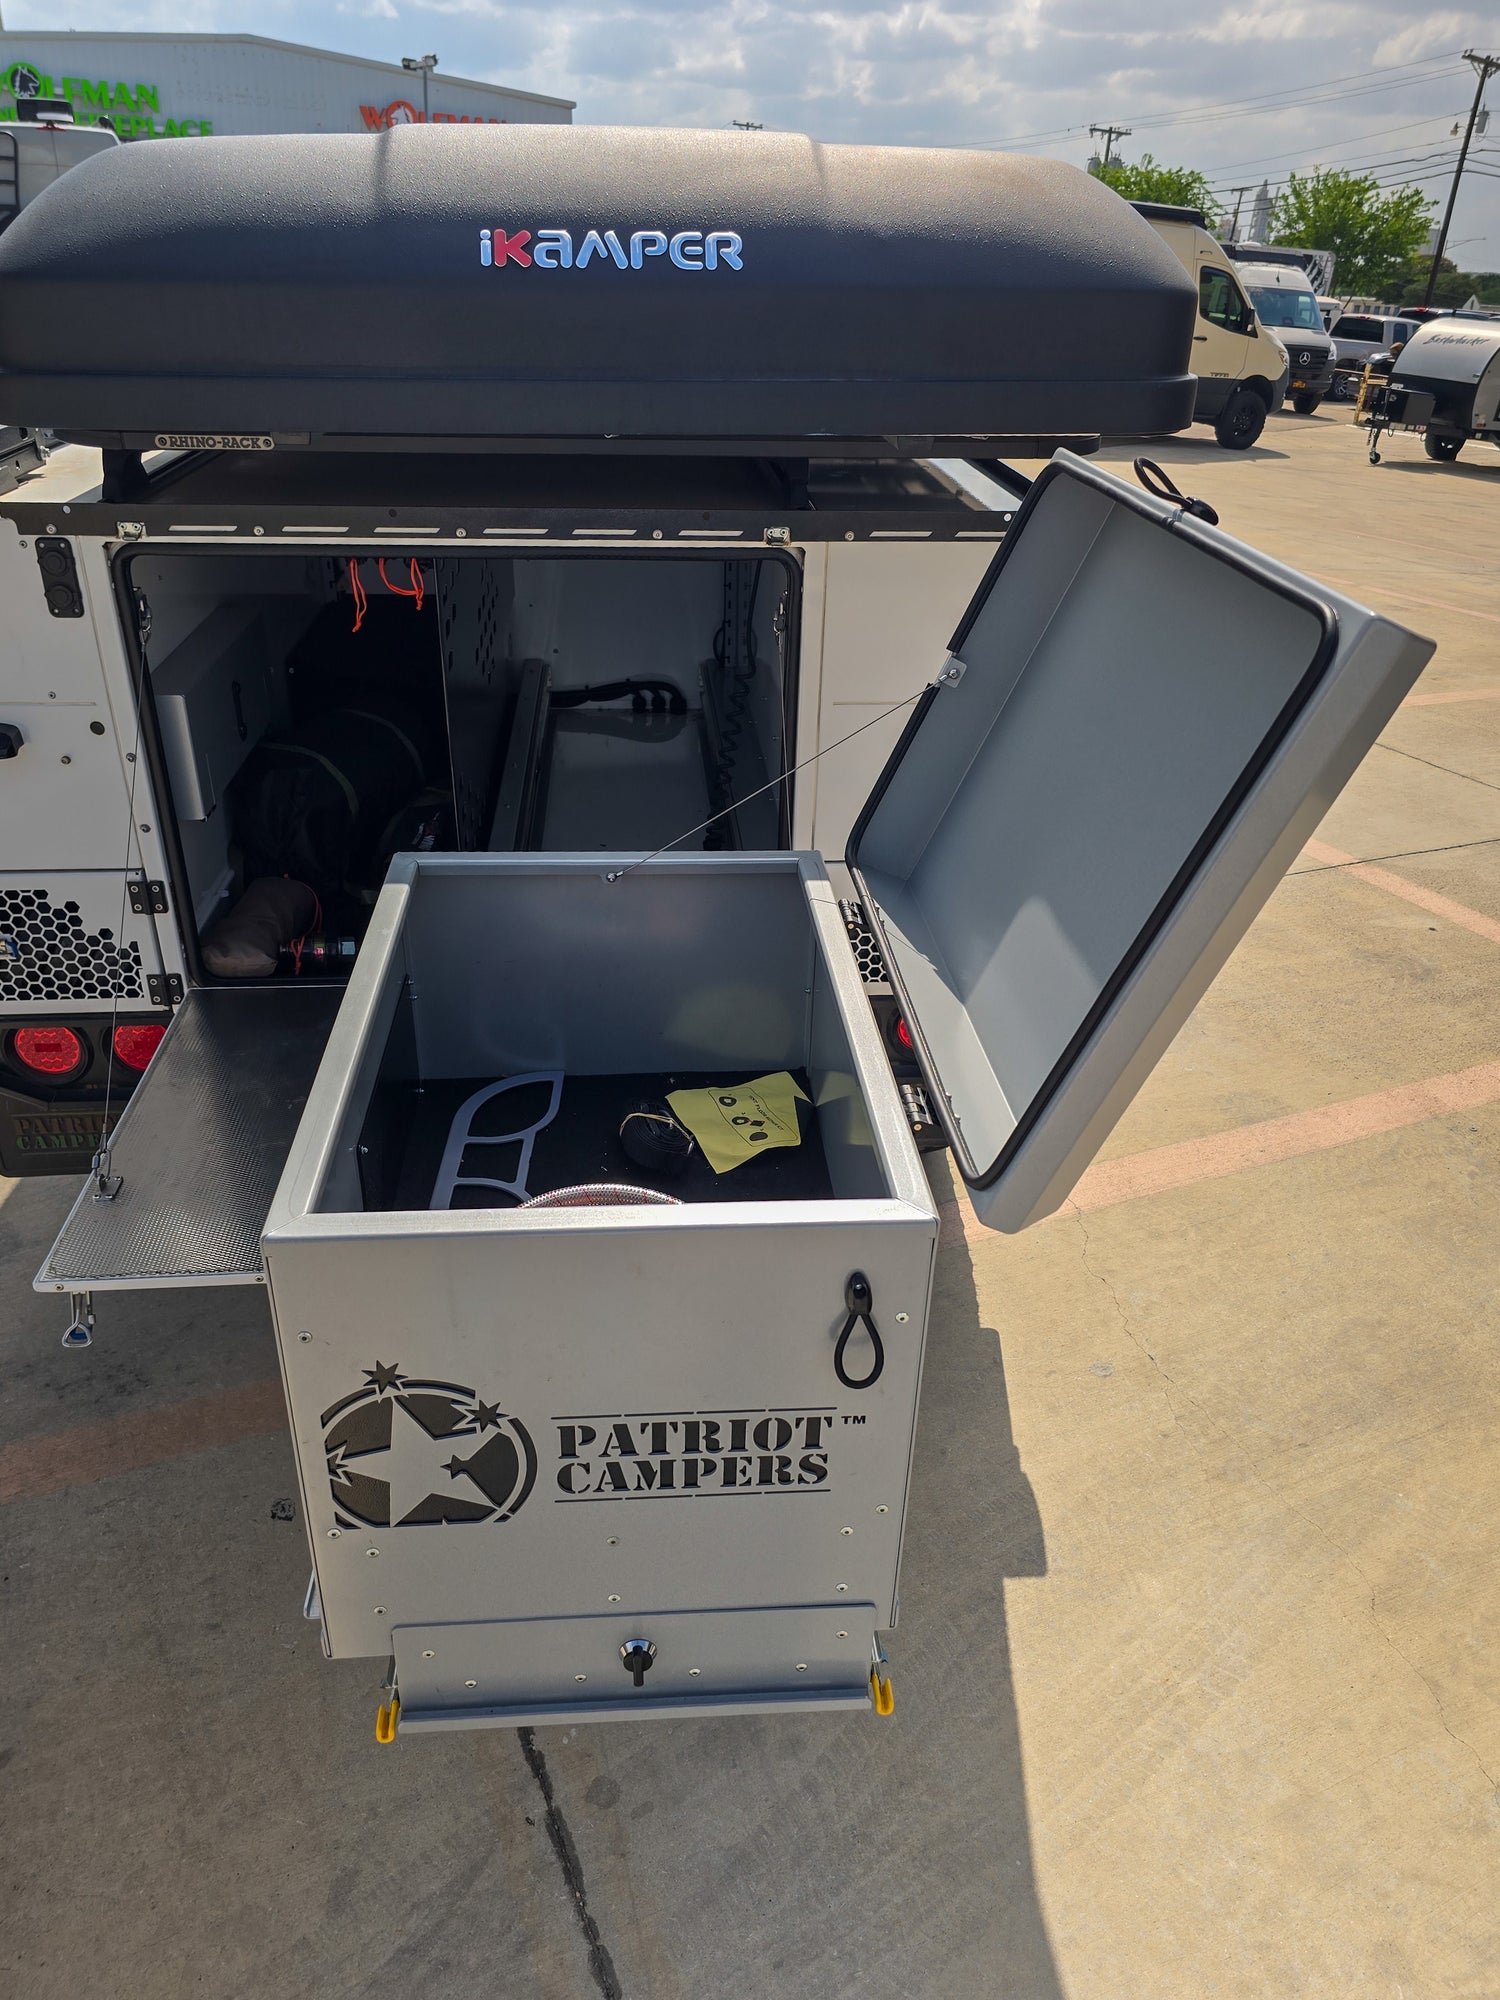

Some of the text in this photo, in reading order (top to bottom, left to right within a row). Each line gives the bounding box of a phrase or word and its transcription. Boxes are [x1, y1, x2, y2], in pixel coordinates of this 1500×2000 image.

[74, 111, 213, 137] FIEPLACE
[168, 435, 262, 449] RHINO-RACK
[15, 1115, 121, 1136] PATRIO
[556, 1416, 833, 1460] PATRIOT
[556, 1453, 829, 1494] CAMPERS
